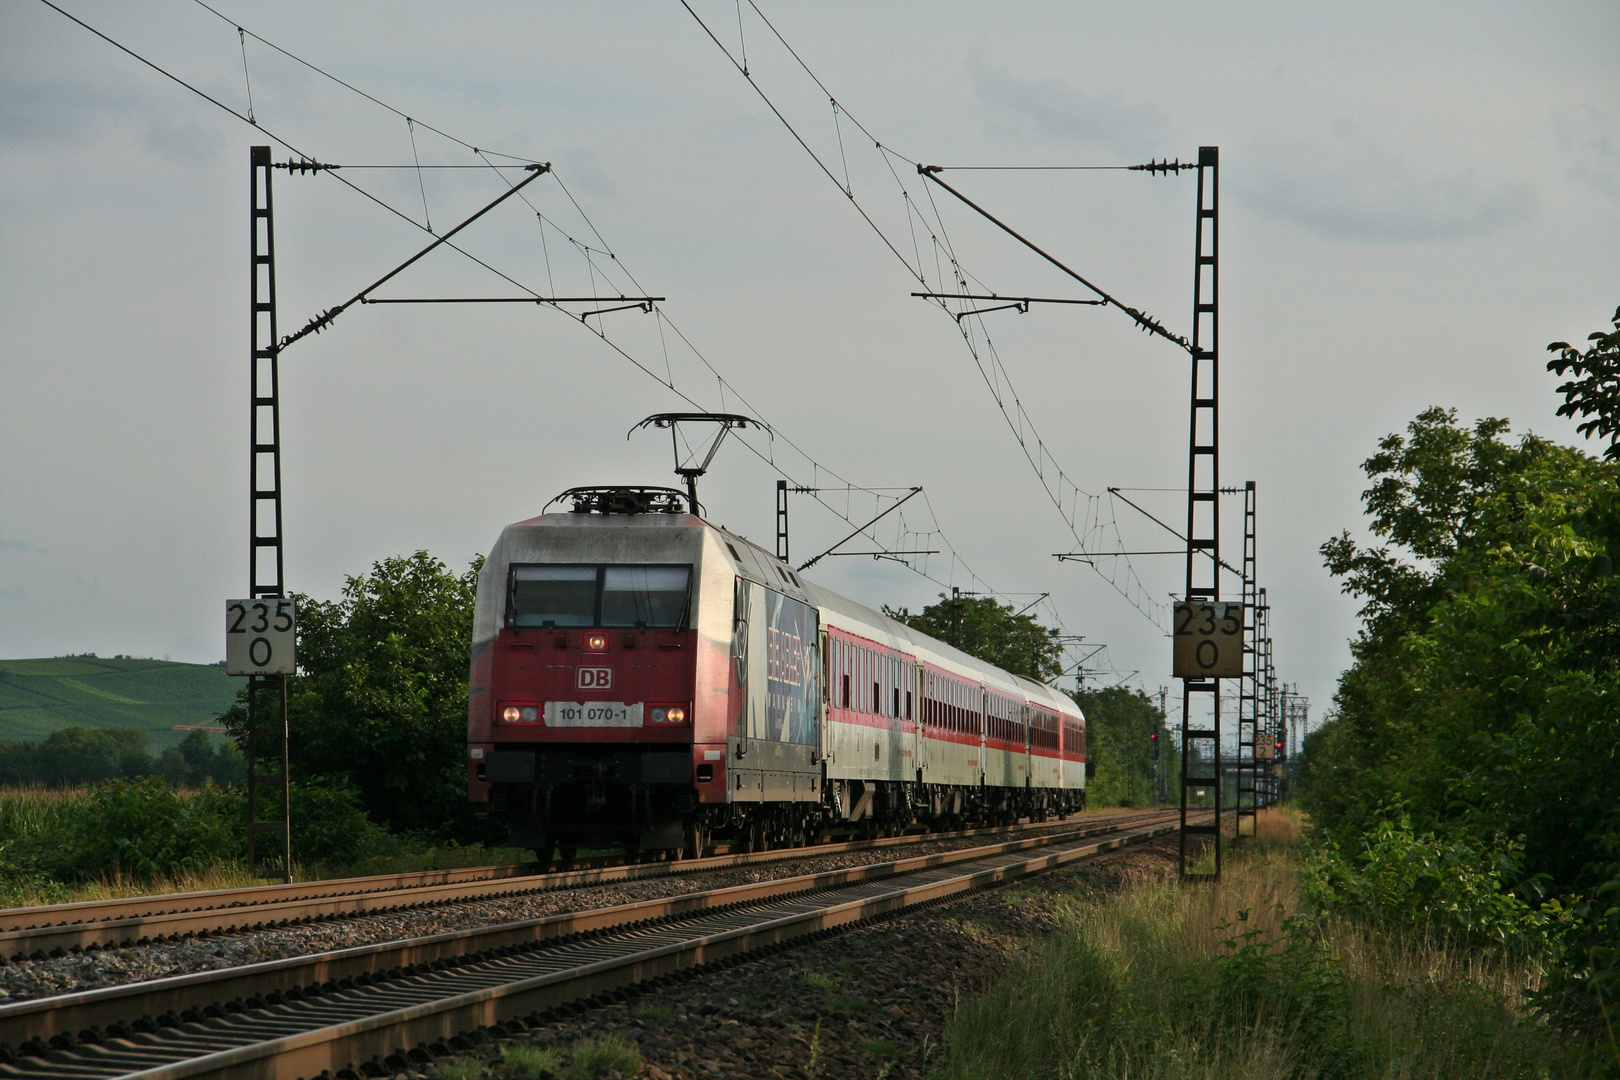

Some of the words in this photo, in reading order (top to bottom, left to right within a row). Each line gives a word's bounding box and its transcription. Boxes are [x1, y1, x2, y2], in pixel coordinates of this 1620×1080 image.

[228, 602, 293, 633] 235
[1175, 605, 1240, 636] 235
[249, 637, 272, 667] 0
[1196, 640, 1219, 669] 0
[580, 670, 610, 687] DB
[560, 708, 582, 719] 101
[588, 708, 627, 719] 070-1
